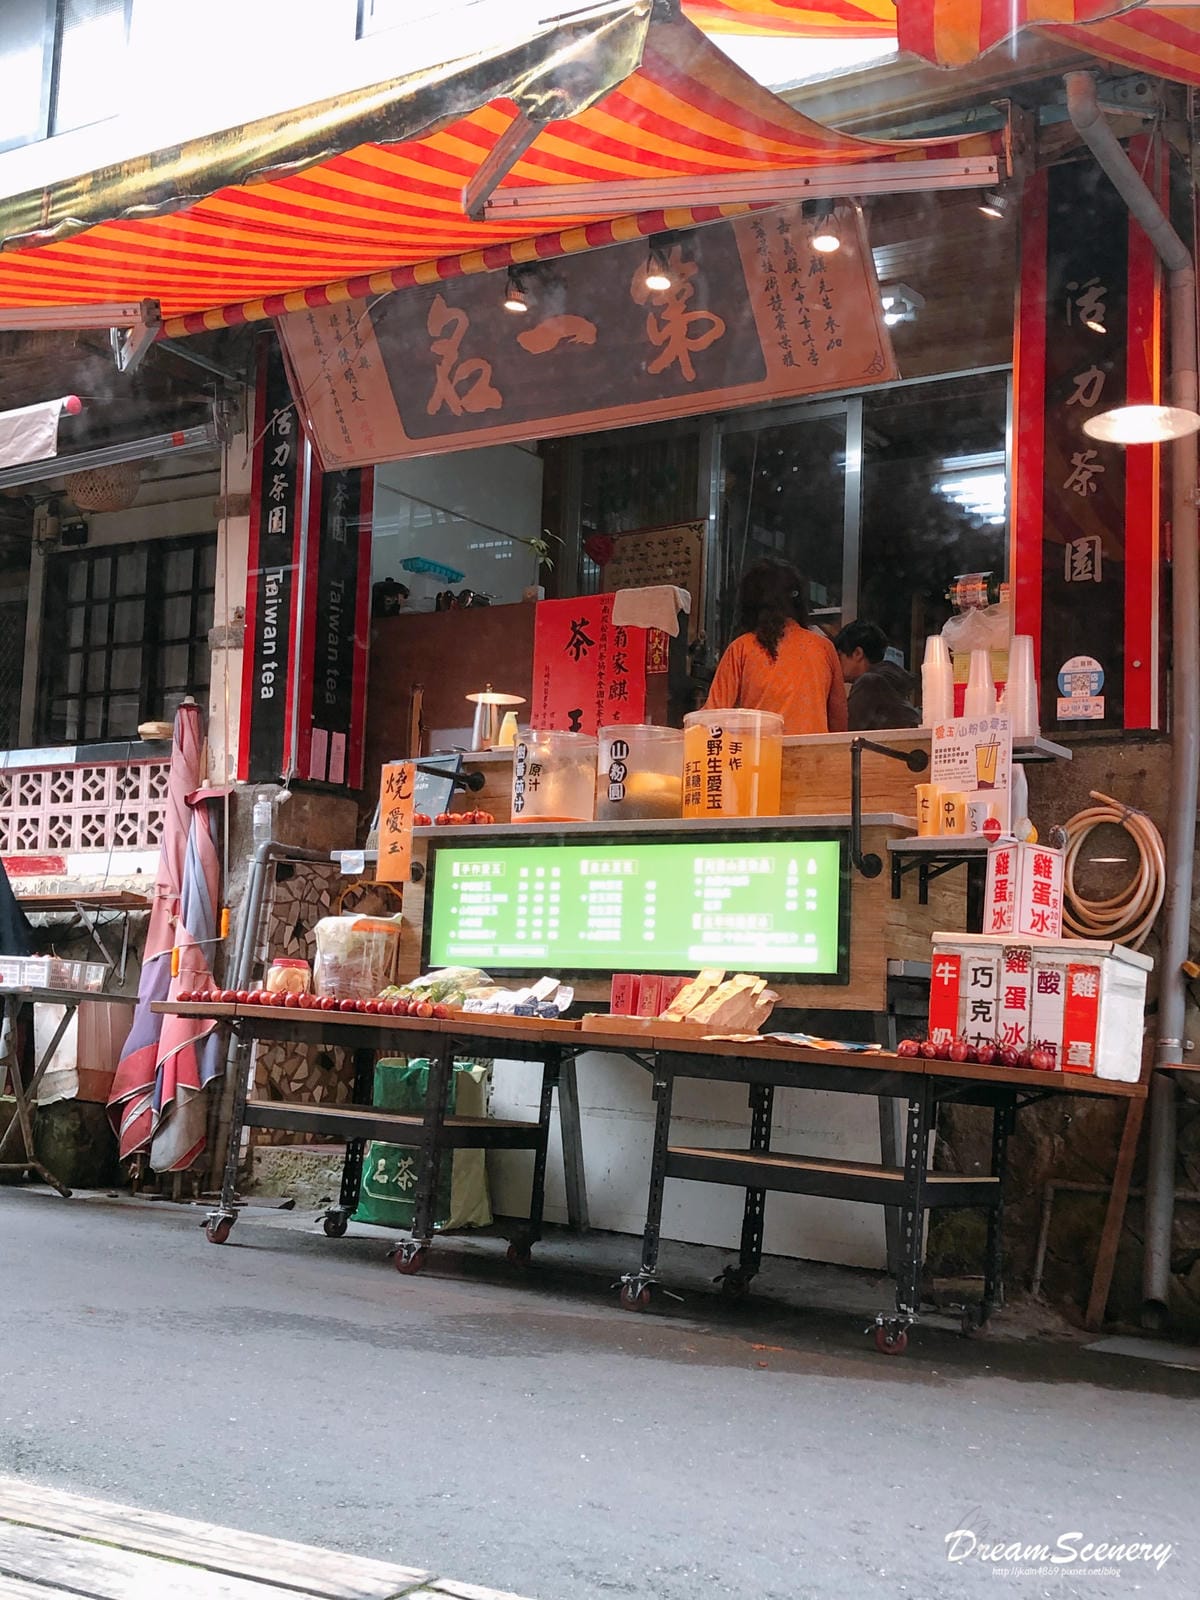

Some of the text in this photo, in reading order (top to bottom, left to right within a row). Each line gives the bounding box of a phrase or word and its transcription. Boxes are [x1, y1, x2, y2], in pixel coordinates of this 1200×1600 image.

[268, 407, 292, 534] 活力茶園
[1063, 283, 1109, 583] 活力茶園
[260, 568, 284, 699] Taiwan tea
[324, 579, 345, 705] Taiwan tea
[564, 617, 596, 733] 茶王
[529, 763, 543, 792] 原汁
[609, 741, 628, 801] 山粉圓
[729, 741, 743, 771] 手作
[945, 817, 956, 828] M
[970, 821, 978, 833] S
[991, 851, 1010, 930] 雞蛋冰
[1029, 852, 1053, 933] 雞蛋冰
[1002, 950, 1029, 1048] 雞蛋冰
[1066, 972, 1097, 1068] 雞蛋
